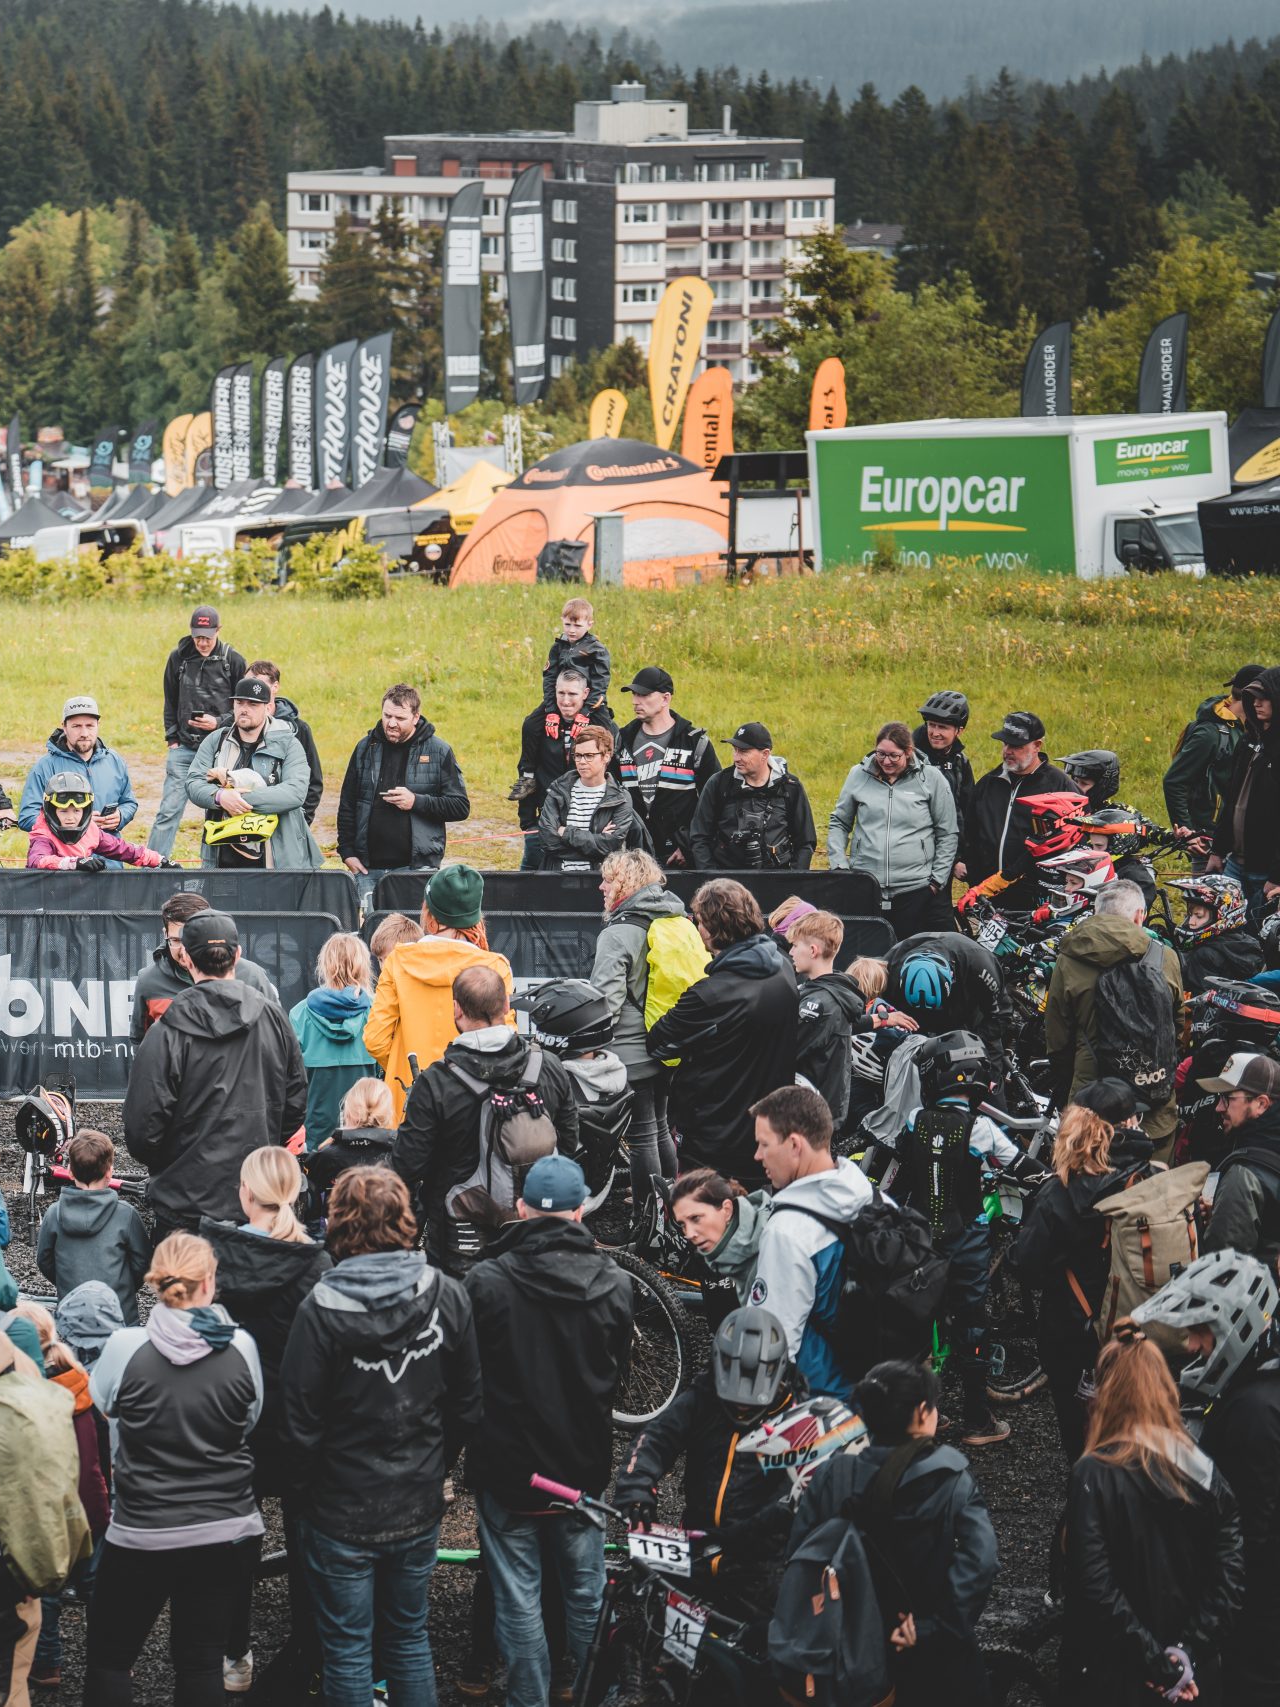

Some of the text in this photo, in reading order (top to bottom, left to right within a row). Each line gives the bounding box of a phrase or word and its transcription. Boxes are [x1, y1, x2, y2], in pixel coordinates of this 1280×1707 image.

[662, 289, 694, 427] CRATONI
[1044, 344, 1057, 417] MAILORDER
[354, 347, 382, 488] STHOUSE
[1116, 438, 1189, 461] Europcar
[585, 458, 667, 481] Continental
[1117, 466, 1149, 478] moving
[1171, 463, 1190, 474] way
[860, 466, 1026, 531] Europcar
[1229, 504, 1280, 517] WWW.BIKE-M
[764, 1442, 818, 1467] 100%
[638, 1539, 683, 1563] 113
